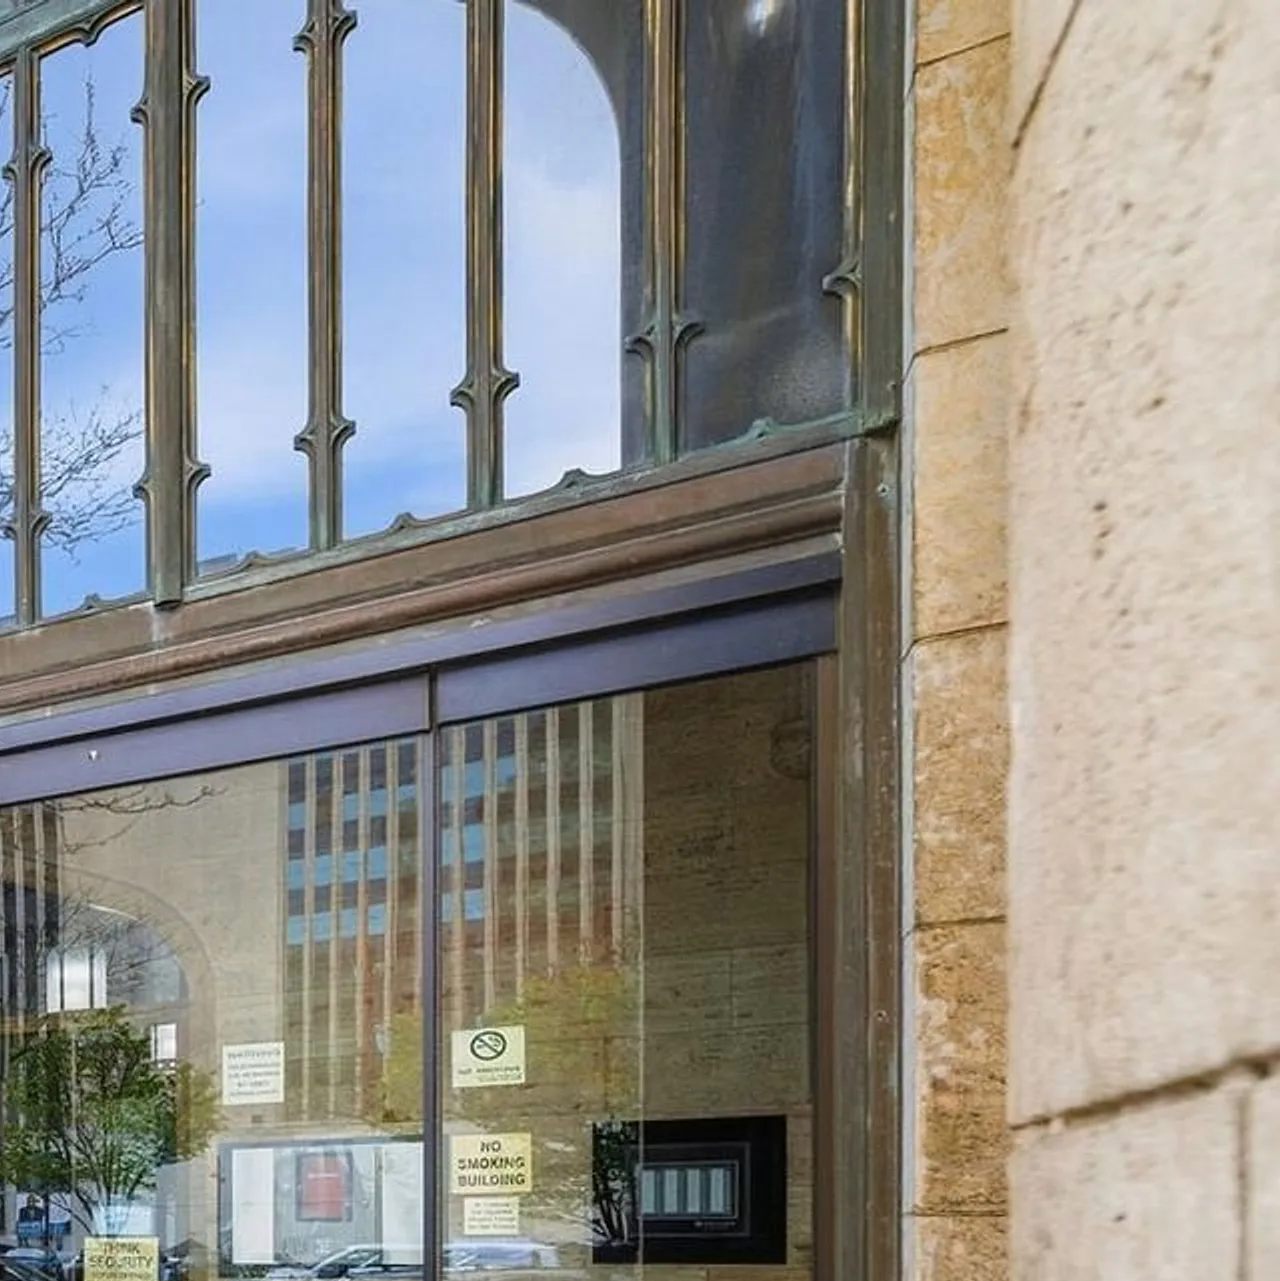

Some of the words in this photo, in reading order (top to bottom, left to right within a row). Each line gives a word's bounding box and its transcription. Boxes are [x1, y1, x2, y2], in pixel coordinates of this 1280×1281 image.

[480, 1140, 501, 1152] NO
[458, 1156, 526, 1170] SMOKING
[458, 1173, 526, 1187] BUILDING
